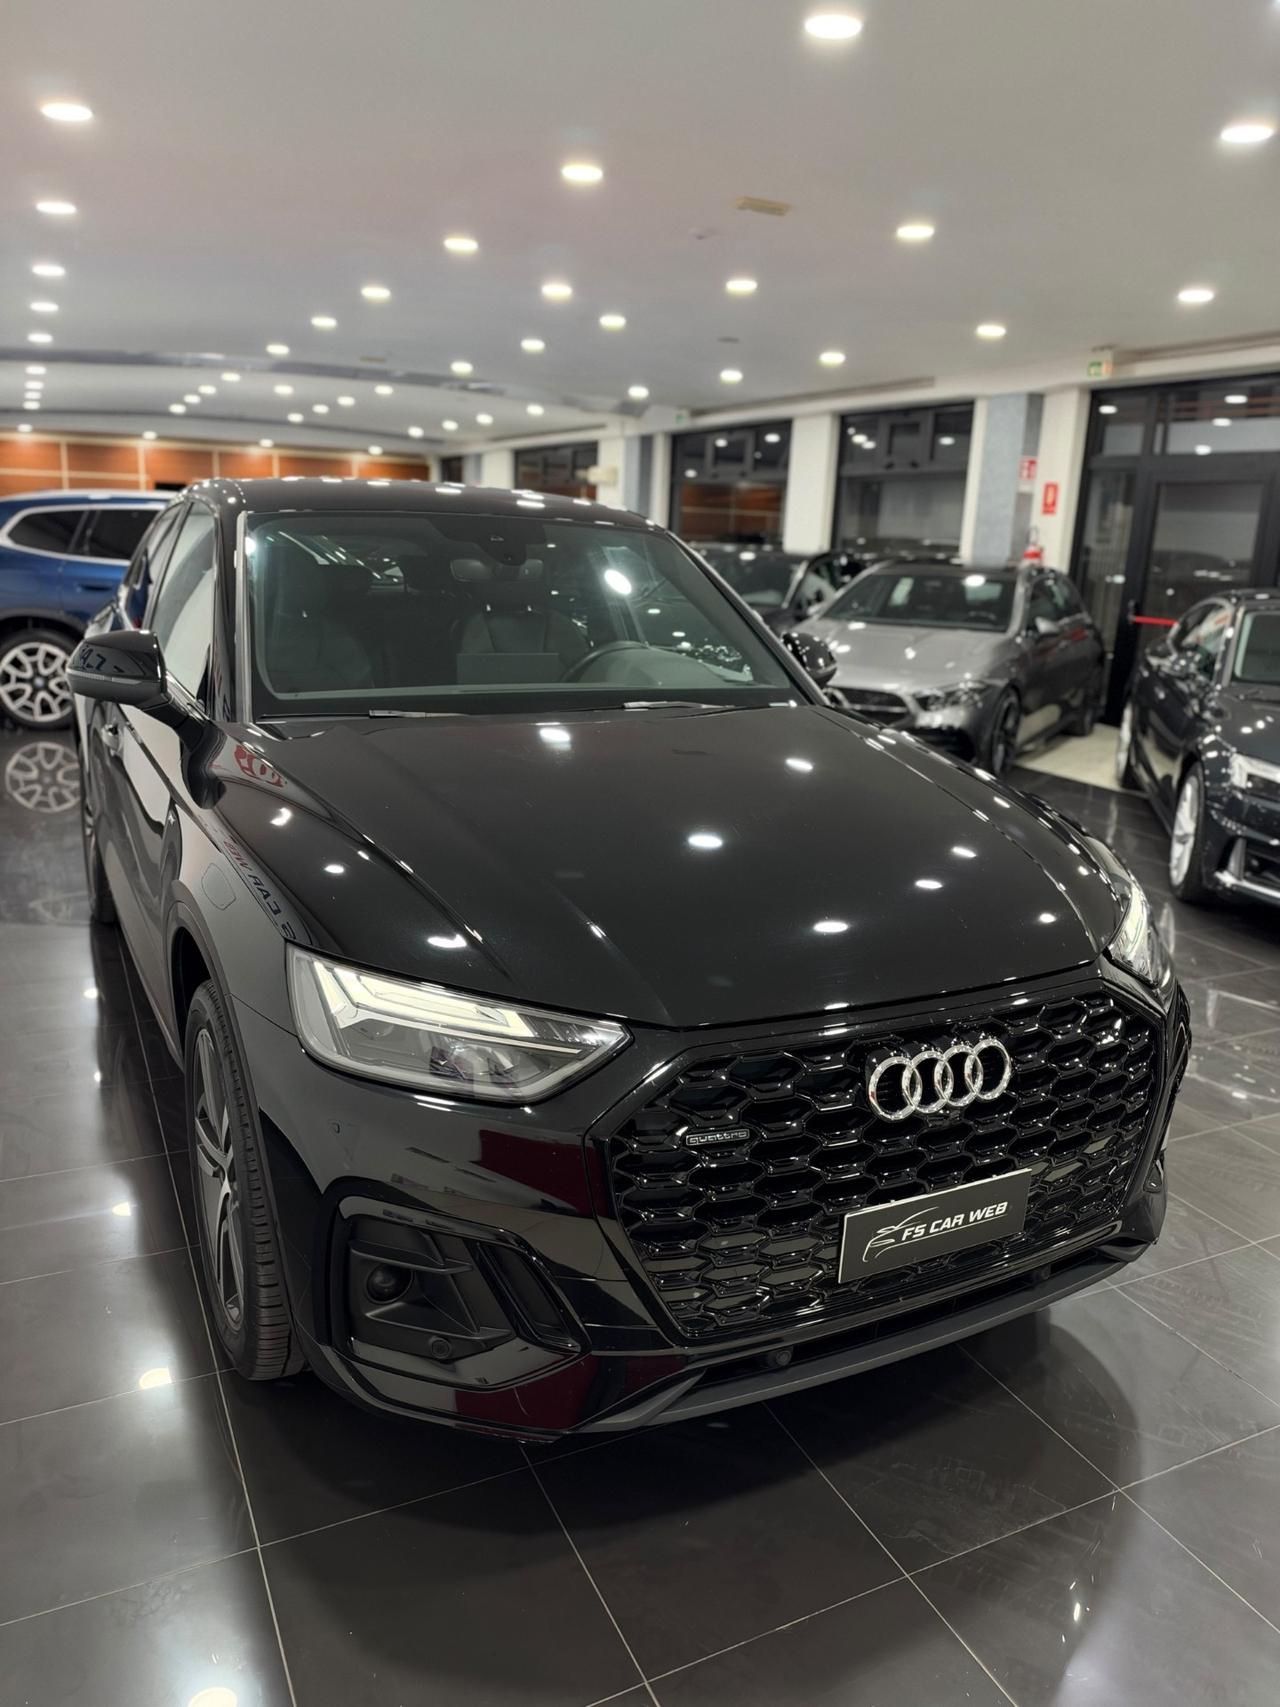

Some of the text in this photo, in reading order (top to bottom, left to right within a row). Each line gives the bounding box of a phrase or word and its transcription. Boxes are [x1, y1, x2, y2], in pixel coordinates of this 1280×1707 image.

[689, 1131, 747, 1145] quattro
[929, 1212, 965, 1234] CAR
[969, 1201, 1009, 1222] WEB
